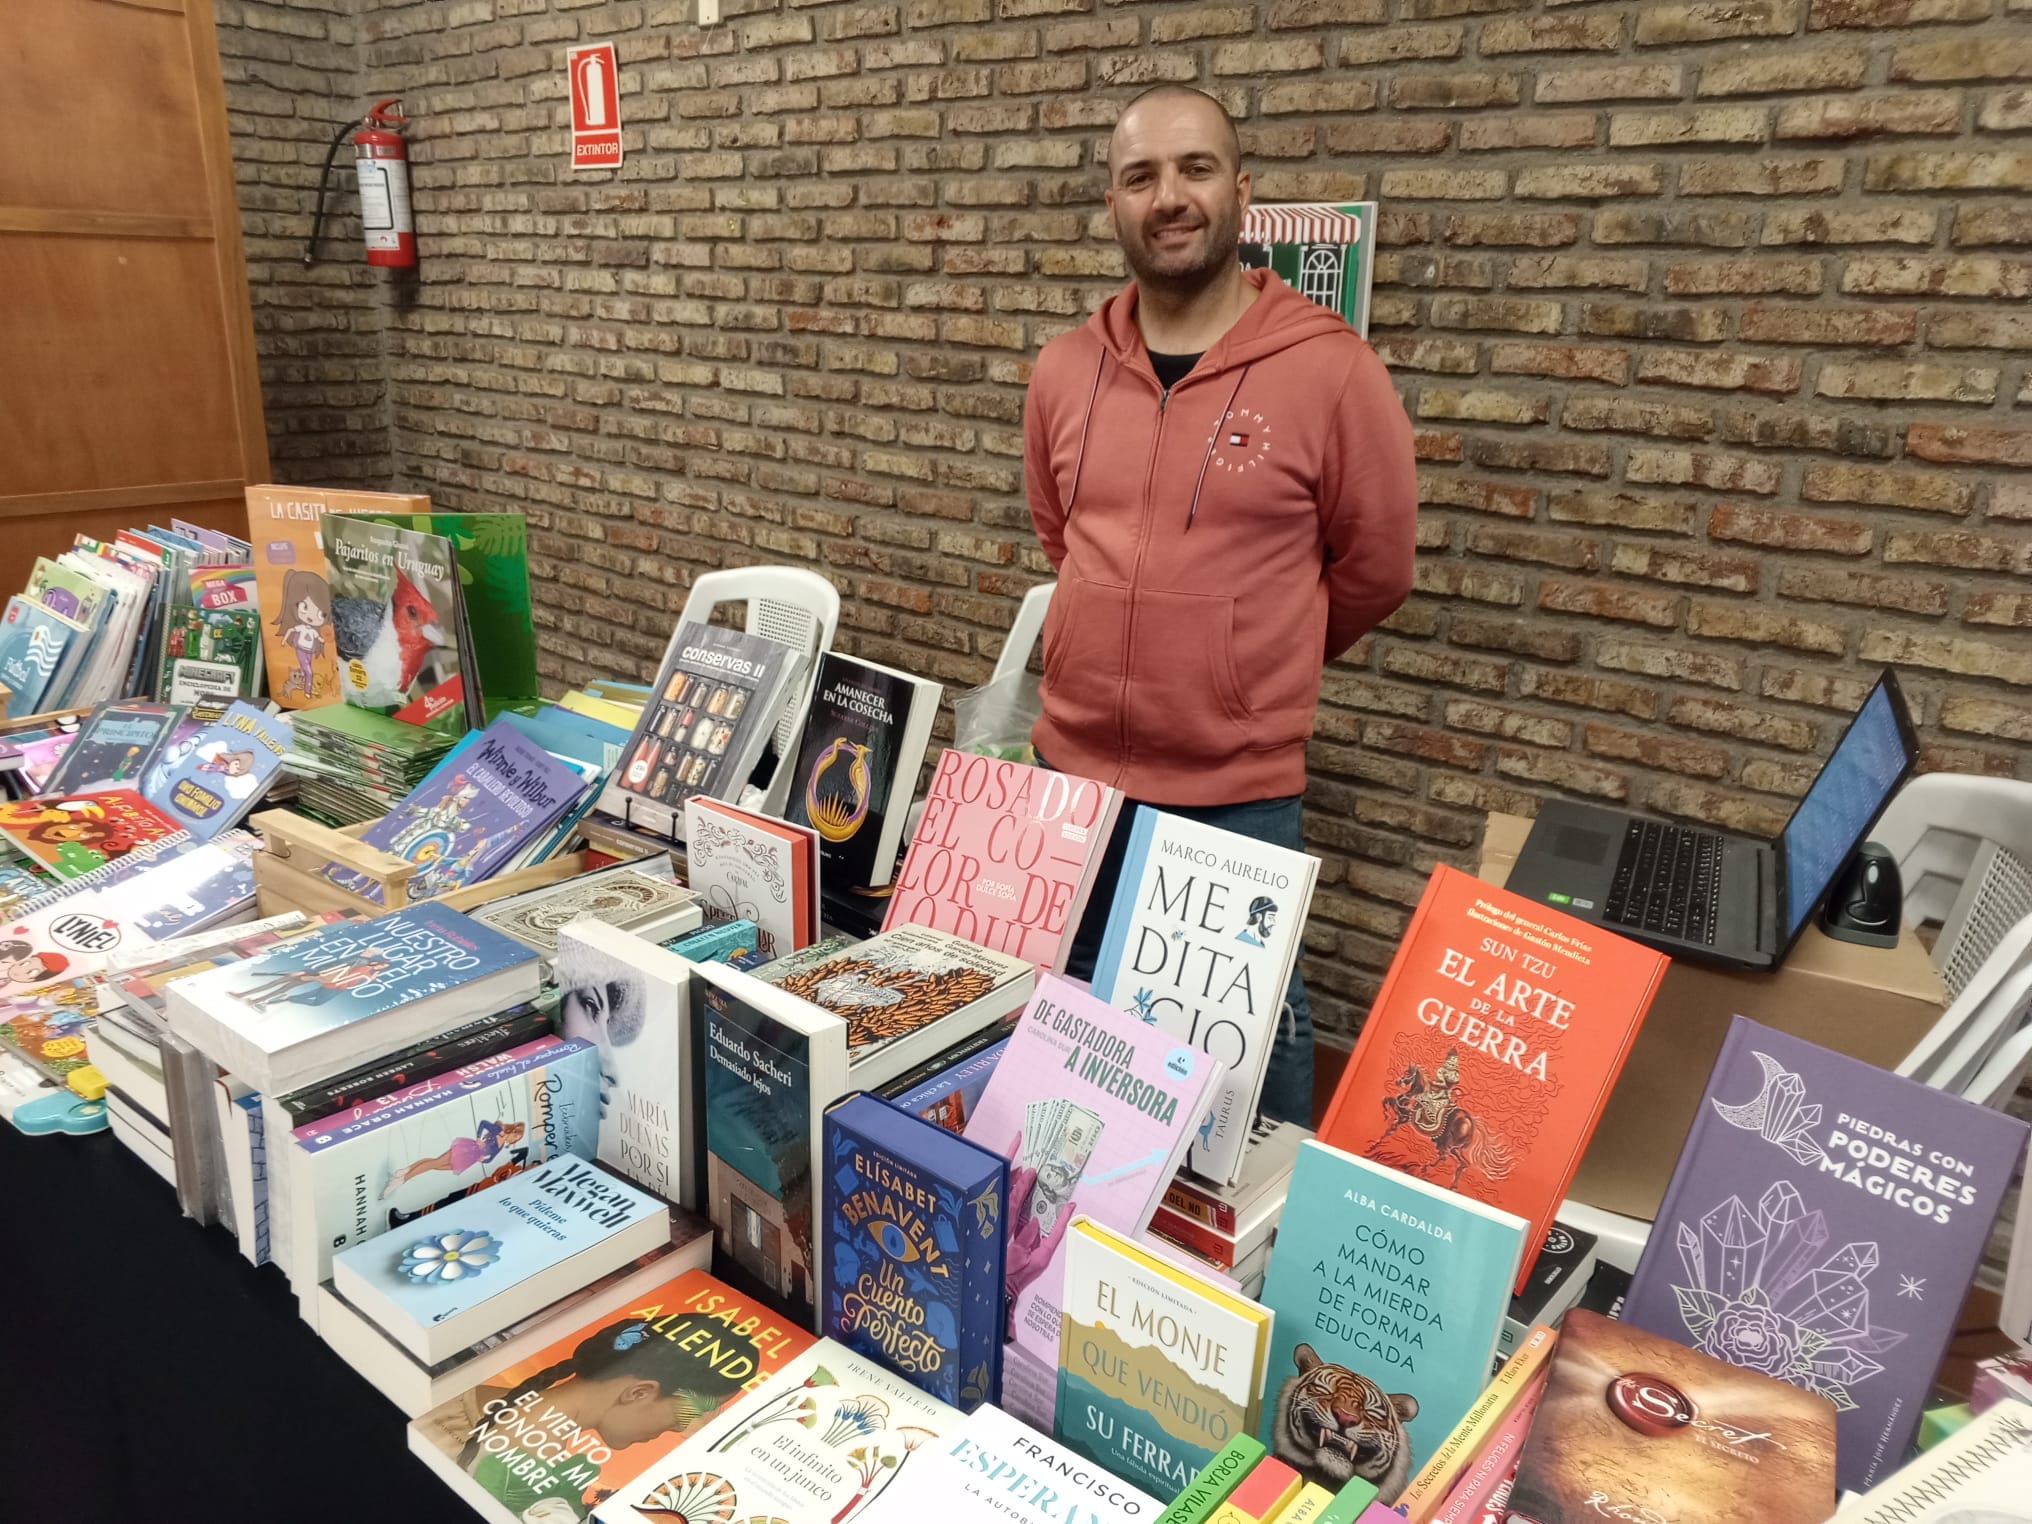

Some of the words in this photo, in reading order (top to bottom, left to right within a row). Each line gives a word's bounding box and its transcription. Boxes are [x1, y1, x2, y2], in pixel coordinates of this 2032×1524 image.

[576, 142, 618, 156] EXTINTOR
[270, 502, 284, 519] LA
[206, 579, 225, 588] MEGA
[335, 538, 379, 564] Pajaritos
[382, 552, 394, 567] en
[397, 552, 445, 582] Uruguay
[211, 590, 238, 607] BOX
[178, 665, 236, 684] MINECRAFT
[682, 646, 752, 674] conservas
[753, 663, 766, 678] II
[823, 689, 836, 703] EN
[837, 695, 848, 708] LA
[849, 700, 894, 725] COSECHA
[834, 682, 885, 709] AMANECER
[477, 739, 517, 778] Winnie
[516, 770, 556, 808] Wilbur
[913, 797, 963, 850] EL
[898, 842, 981, 908] LOR
[1014, 872, 1075, 936] DE
[1160, 839, 1217, 868] MARCO
[1220, 858, 1289, 890] AURELIO
[1147, 865, 1231, 934] ME
[54, 916, 116, 949] LYNIEL
[374, 917, 480, 970] NUESTRO
[952, 940, 983, 953] Gabriel
[1467, 907, 1513, 932] Ilustraciones
[1512, 927, 1523, 936] de
[1523, 931, 1552, 948] Gastón
[1552, 943, 1591, 965] Mendieta
[1503, 911, 1516, 921] del
[1515, 917, 1544, 933] general
[1543, 927, 1570, 943] Carlos
[322, 937, 366, 959] EN
[376, 968, 411, 990] EL
[358, 932, 438, 976] LUGAR
[891, 933, 915, 944] Cien
[915, 939, 943, 953] años
[943, 951, 959, 959] de
[959, 957, 1006, 977] soledad
[1131, 925, 1256, 1016] DITA
[1480, 937, 1518, 962] SUN
[1521, 953, 1557, 979] TZU
[1436, 948, 1477, 988] EL
[1484, 972, 1575, 1030] ARTE
[1470, 998, 1492, 1015] DE
[1496, 1009, 1516, 1027] LA
[532, 1042, 582, 1063] Romper
[709, 1021, 751, 1061] Eduardo
[752, 1051, 792, 1087] Sacheri
[1033, 999, 1053, 1024] DE
[1053, 1009, 1136, 1069] GASTADORA
[1416, 997, 1550, 1081] GUERRA
[326, 1073, 378, 1097] ROBERTS
[380, 1061, 416, 1079] LAUREN
[455, 1053, 512, 1077] WALSH
[709, 1045, 752, 1085] Demasiado
[752, 1072, 771, 1096] lejos
[958, 1056, 990, 1080] RILEY
[1064, 1046, 1082, 1072] A
[1079, 1055, 1179, 1127] INVERSORA
[379, 1093, 399, 1106] 13
[396, 1090, 453, 1116] HANNAH
[532, 1073, 562, 1153] Romper
[628, 1089, 669, 1132] MARÍA
[910, 1086, 940, 1103] chica
[1215, 1089, 1234, 1138] TAURUS
[342, 1111, 391, 1134] GRACE
[620, 1112, 669, 1158] DUEÑAS
[1837, 1112, 1925, 1157] PIEDRAS
[1929, 1151, 1975, 1178] CON
[621, 1139, 652, 1176] POR
[657, 1162, 669, 1186] SI
[855, 1153, 937, 1214] ELÍSABET
[873, 1151, 894, 1167] EDICIÓN
[894, 1162, 918, 1179] LIMITADA
[1828, 1130, 1977, 1205] PODERES
[354, 1174, 368, 1236] HANNAH
[527, 1168, 632, 1230] Maxwell
[529, 1199, 568, 1225] Pídeme
[556, 1162, 637, 1214] Megan
[1818, 1156, 1952, 1225] MÁGICOS
[499, 1197, 511, 1208] lo
[509, 1202, 529, 1221] que
[526, 1213, 568, 1242] quieras
[842, 1189, 949, 1278] BENAVENT
[1344, 1189, 1376, 1211] ALBA
[1380, 1204, 1453, 1243] CARDALDA
[1355, 1224, 1425, 1265] CÓMO
[879, 1258, 905, 1295] Un
[1337, 1244, 1431, 1296] MANDAR
[858, 1273, 925, 1326] Cuento
[1161, 1292, 1193, 1313] LIMITADA
[1312, 1260, 1326, 1278] A
[1334, 1268, 1357, 1292] LA
[1364, 1281, 1443, 1331] MIERDA
[1318, 1287, 1343, 1313] DE
[1350, 1302, 1424, 1350] FORMA
[630, 1303, 773, 1393] ALLENDE
[685, 1288, 793, 1360] ISABEL
[841, 1292, 946, 1374] Perfecto
[1024, 1316, 1054, 1342] NOSOTRAS
[1035, 1315, 1056, 1334] ESPERA
[1097, 1279, 1121, 1320] EL
[1131, 1300, 1228, 1377] MONJE
[1315, 1312, 1415, 1373] EDUCADA
[847, 1361, 881, 1386] IRENE
[881, 1381, 938, 1418] VALLEJO
[1082, 1340, 1128, 1387] QUE
[1137, 1369, 1229, 1442] VENDIÓ
[513, 1389, 537, 1407] EL
[540, 1404, 612, 1466] VIENTO
[1086, 1404, 1114, 1440] SU
[1416, 1458, 1447, 1490] Secretos
[1450, 1423, 1473, 1450] Mente
[1466, 1393, 1499, 1428] Millonaria
[1504, 1365, 1518, 1381] Harv
[1515, 1353, 1531, 1368] Eker
[1632, 1386, 1787, 1450] Secret
[467, 1422, 558, 1496] NOMBRE
[481, 1398, 570, 1468] CONOCE
[562, 1465, 602, 1493] MI
[772, 1434, 790, 1448] El
[789, 1442, 844, 1486] infinito
[1204, 1450, 1245, 1485] BORJA
[1485, 1441, 1507, 1473] FELICES
[1695, 1434, 1708, 1445] EL
[1710, 1440, 1760, 1464] SECRETO
[750, 1444, 769, 1460] en
[768, 1455, 790, 1472] un
[785, 1465, 832, 1502] junco
[965, 1483, 980, 1496] LA
[1012, 1437, 1141, 1515] FRANCISCO
[1110, 1447, 1126, 1461] Una
[1125, 1456, 1149, 1476] fábula
[1148, 1469, 1182, 1495] espiritual
[1461, 1479, 1481, 1502] PARA
[1291, 1498, 1315, 1520] ALBA
